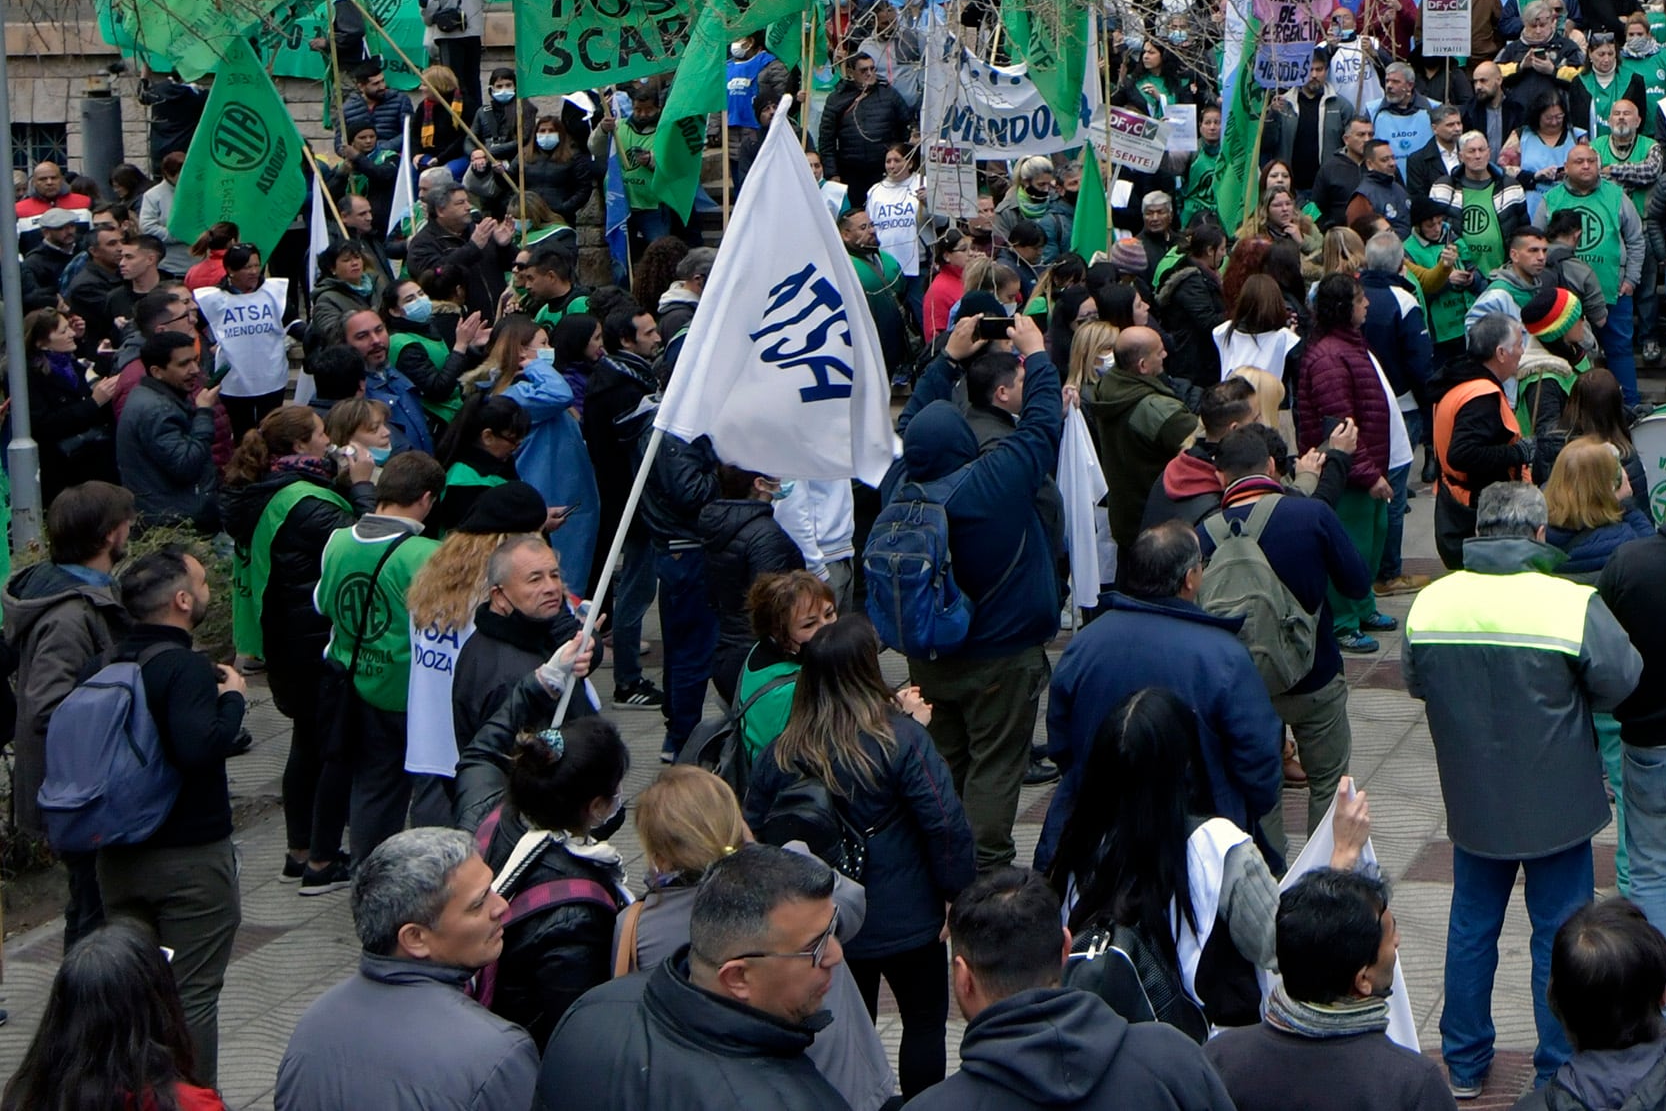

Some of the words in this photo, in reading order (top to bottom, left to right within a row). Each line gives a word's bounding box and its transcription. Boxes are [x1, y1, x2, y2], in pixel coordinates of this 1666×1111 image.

[1279, 5, 1297, 24] DE
[1428, 0, 1457, 11] DFyC
[878, 202, 915, 219] ATSA
[1464, 207, 1488, 232] ATE
[223, 304, 273, 325] ATSA
[224, 323, 275, 338] MENDOZA
[748, 262, 854, 403] ATSA
